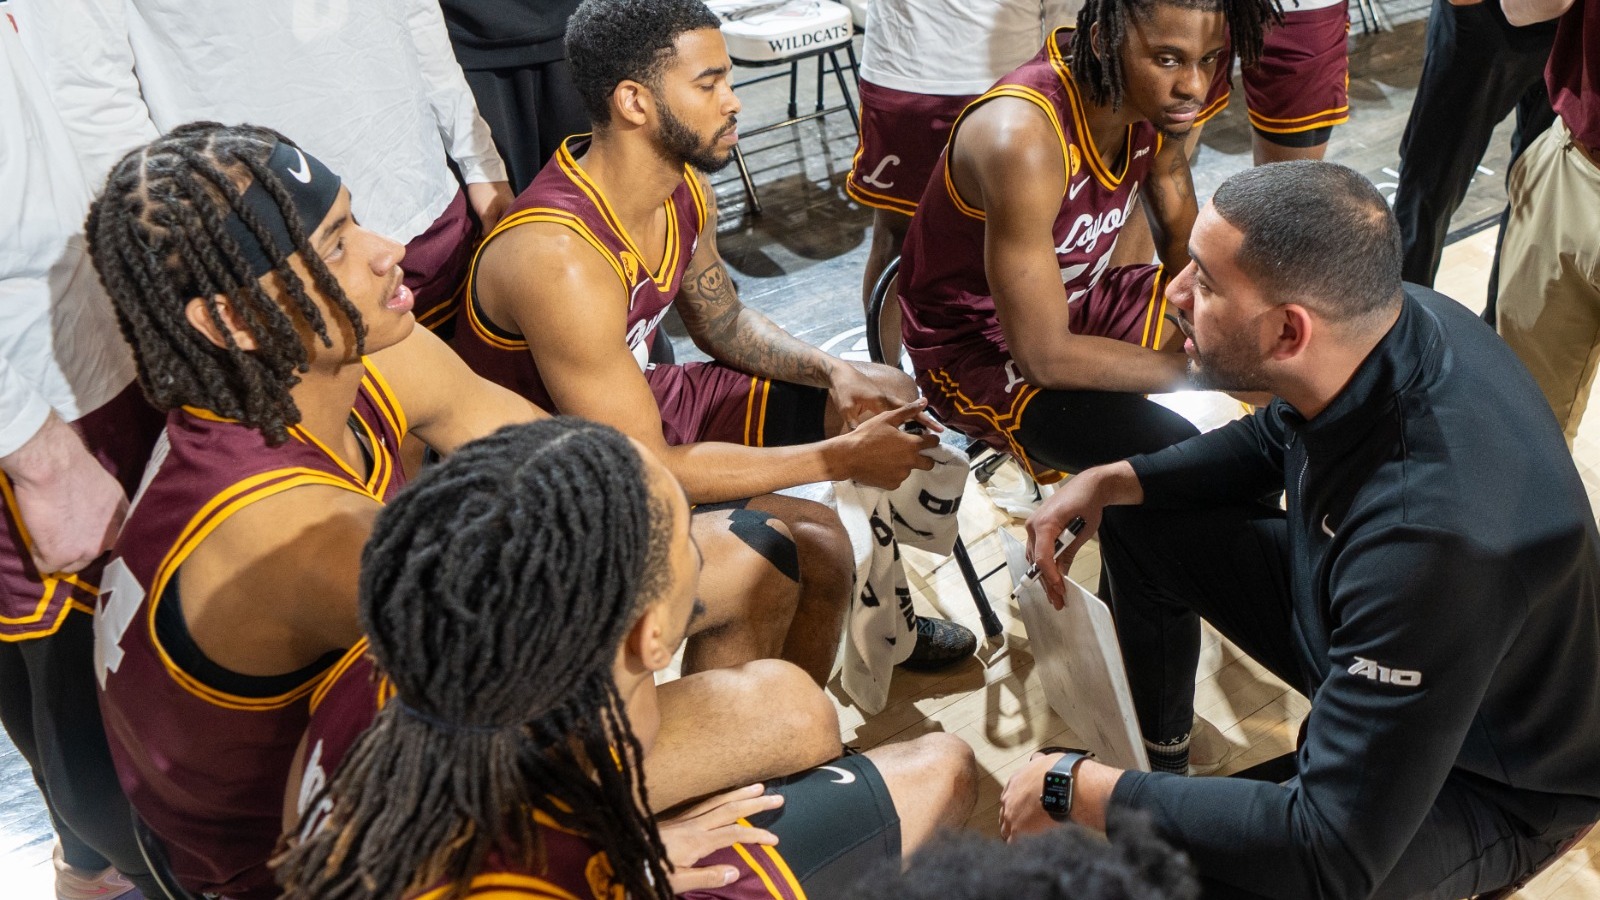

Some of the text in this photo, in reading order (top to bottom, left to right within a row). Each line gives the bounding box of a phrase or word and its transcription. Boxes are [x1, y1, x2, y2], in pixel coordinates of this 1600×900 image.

[768, 23, 849, 53] WILDCATS
[862, 154, 901, 189] L
[1055, 181, 1139, 254] Loyol
[1347, 655, 1422, 687] A10
